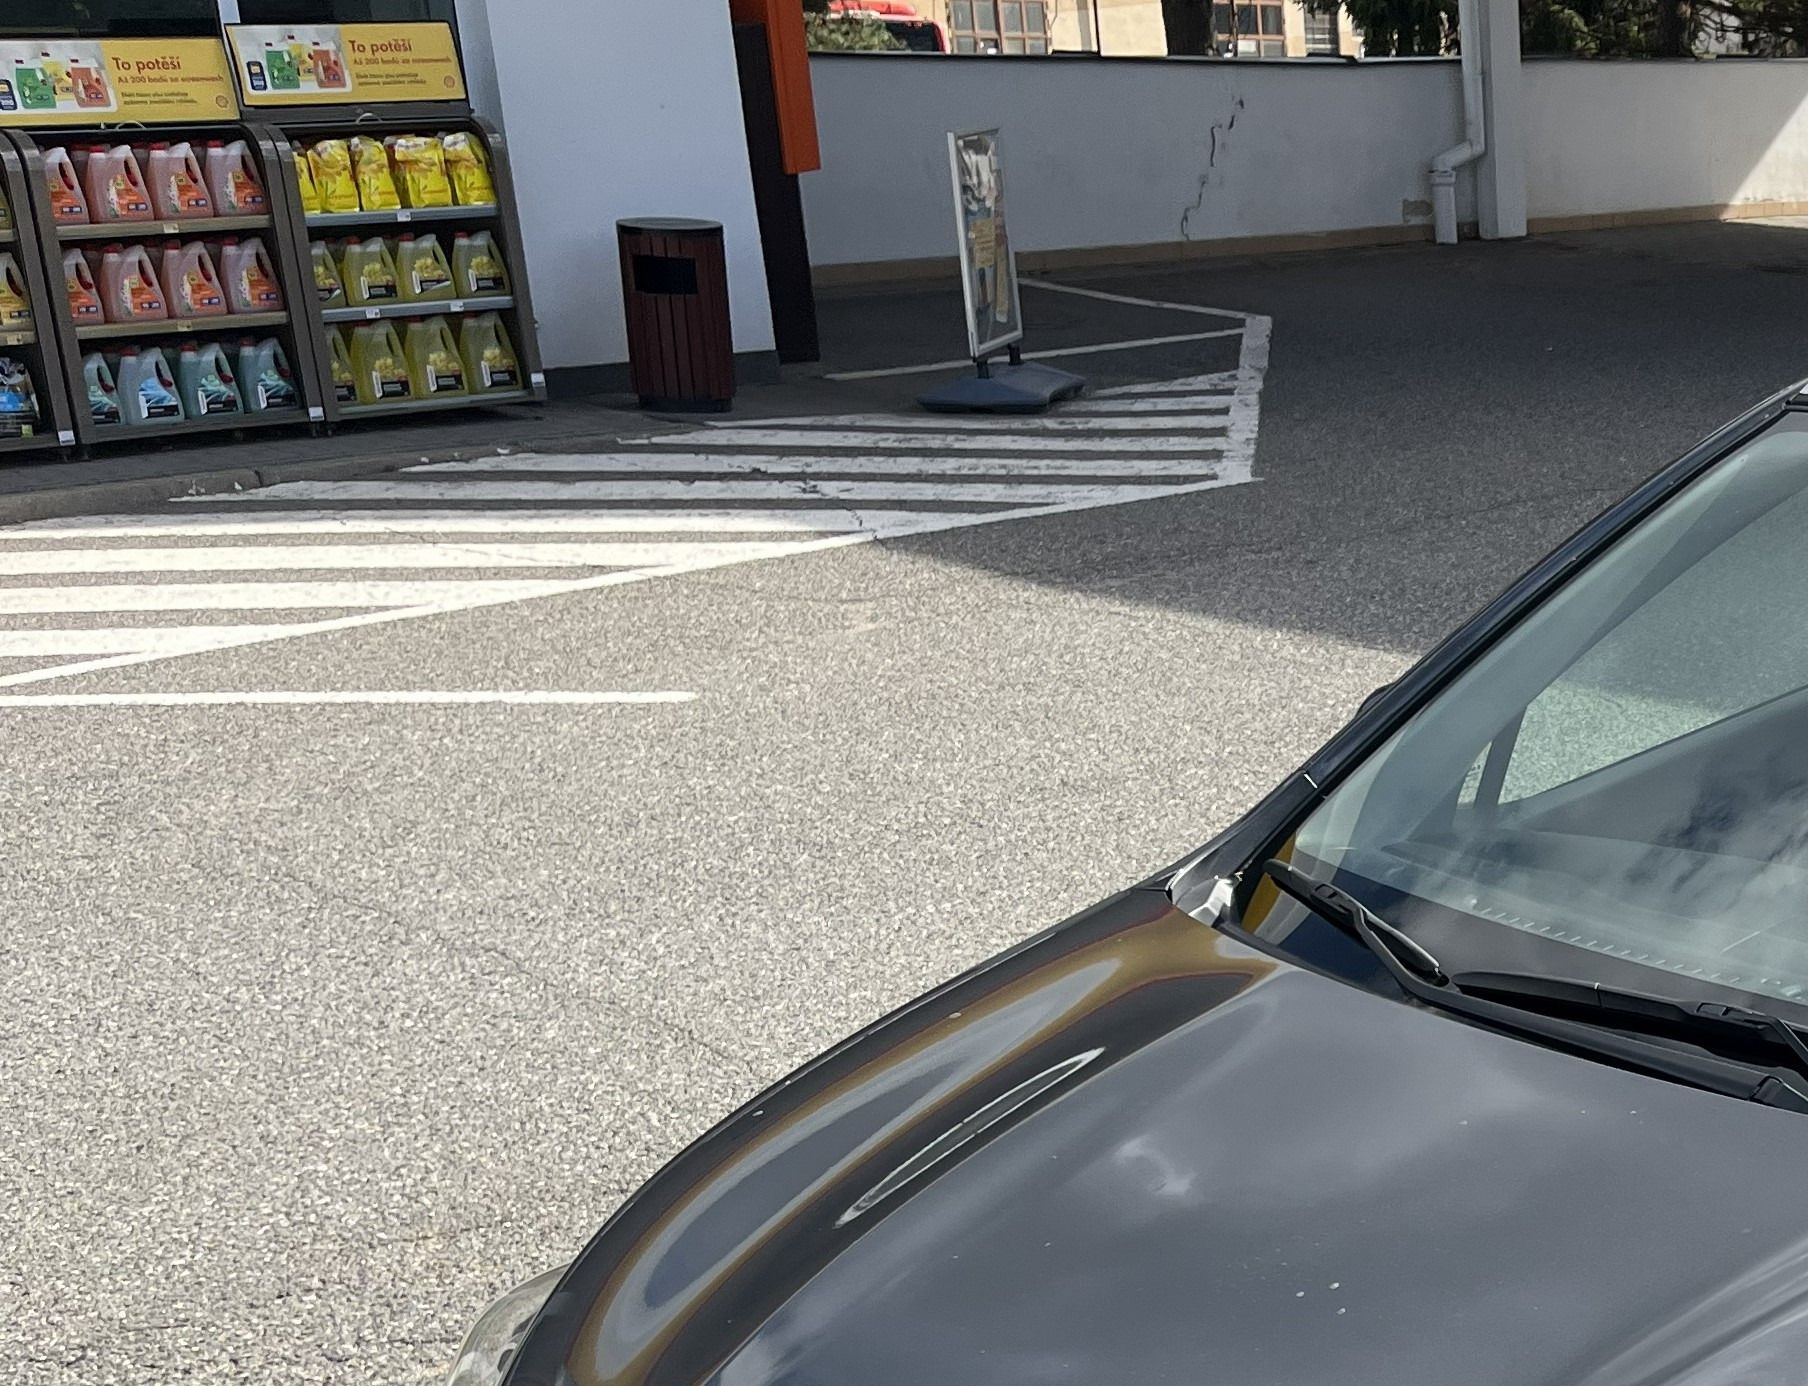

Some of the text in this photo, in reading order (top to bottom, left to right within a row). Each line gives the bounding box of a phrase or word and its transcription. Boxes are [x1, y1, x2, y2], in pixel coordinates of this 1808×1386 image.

[348, 40, 366, 53] To
[111, 55, 182, 75] To potěší
